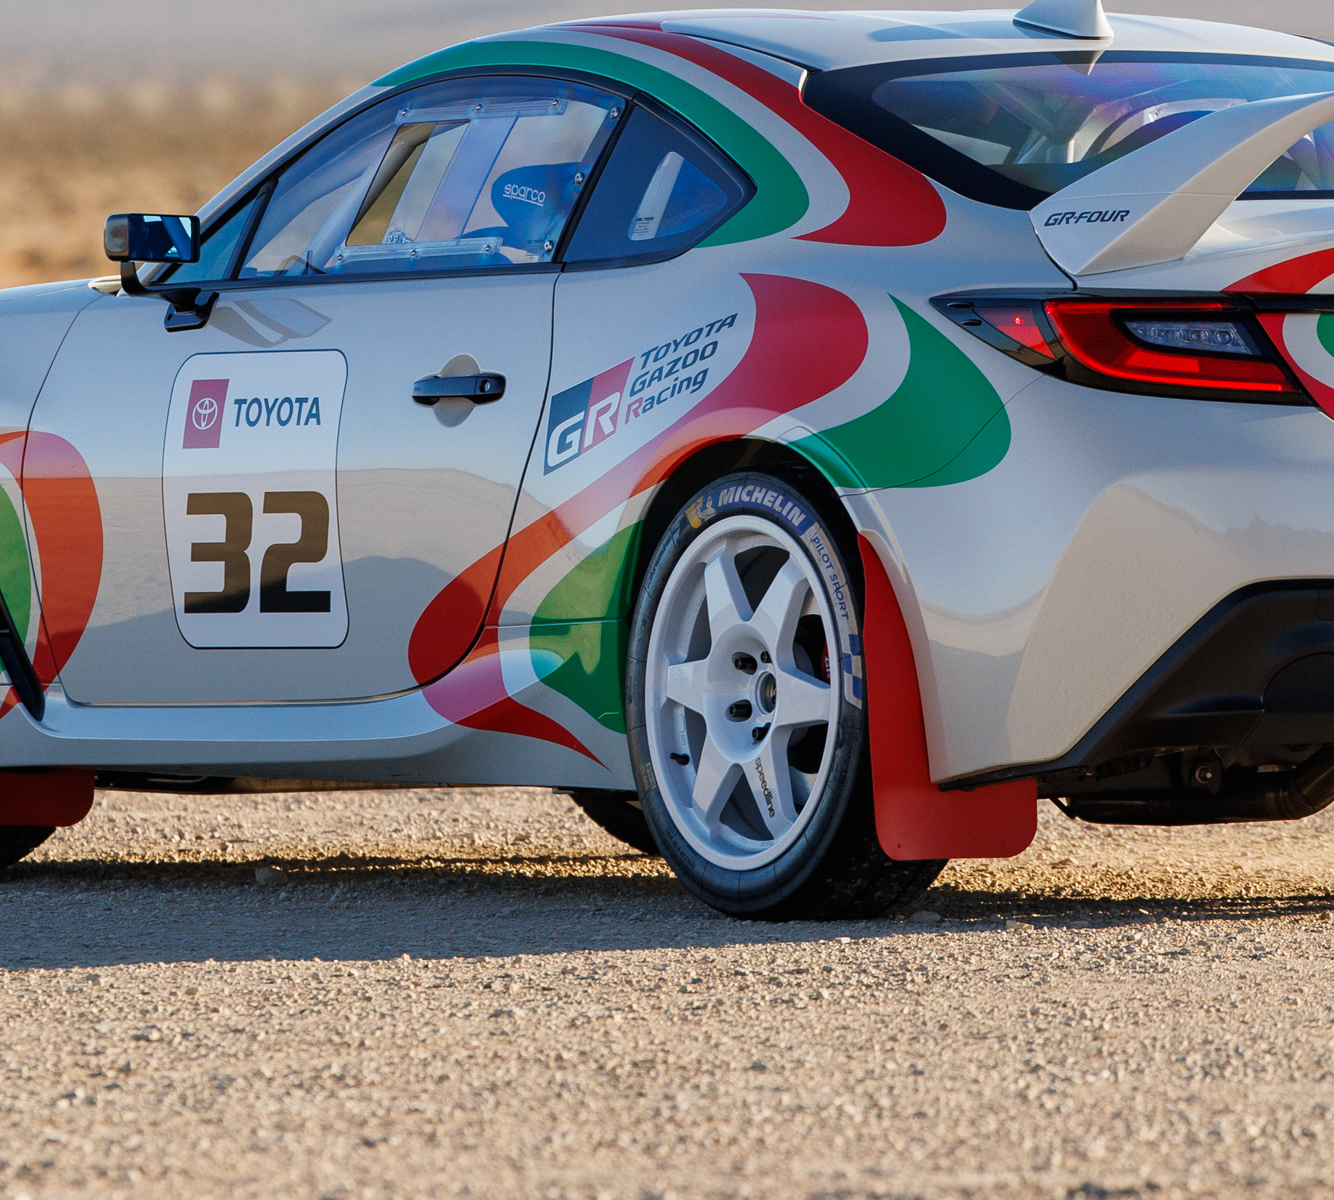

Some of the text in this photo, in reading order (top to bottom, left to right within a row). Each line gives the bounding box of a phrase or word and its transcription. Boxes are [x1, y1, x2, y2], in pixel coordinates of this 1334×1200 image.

[504, 184, 546, 203] sparco
[629, 340, 719, 397] GAZOO
[639, 312, 739, 371] TOYOTA
[233, 397, 321, 427] TOYOTA
[624, 367, 709, 426] Racing
[547, 391, 621, 468] GR
[717, 484, 807, 527] MICHELIN
[183, 490, 331, 614] 32
[811, 536, 850, 620] PILOT SPORT
[754, 757, 776, 818] speedline
